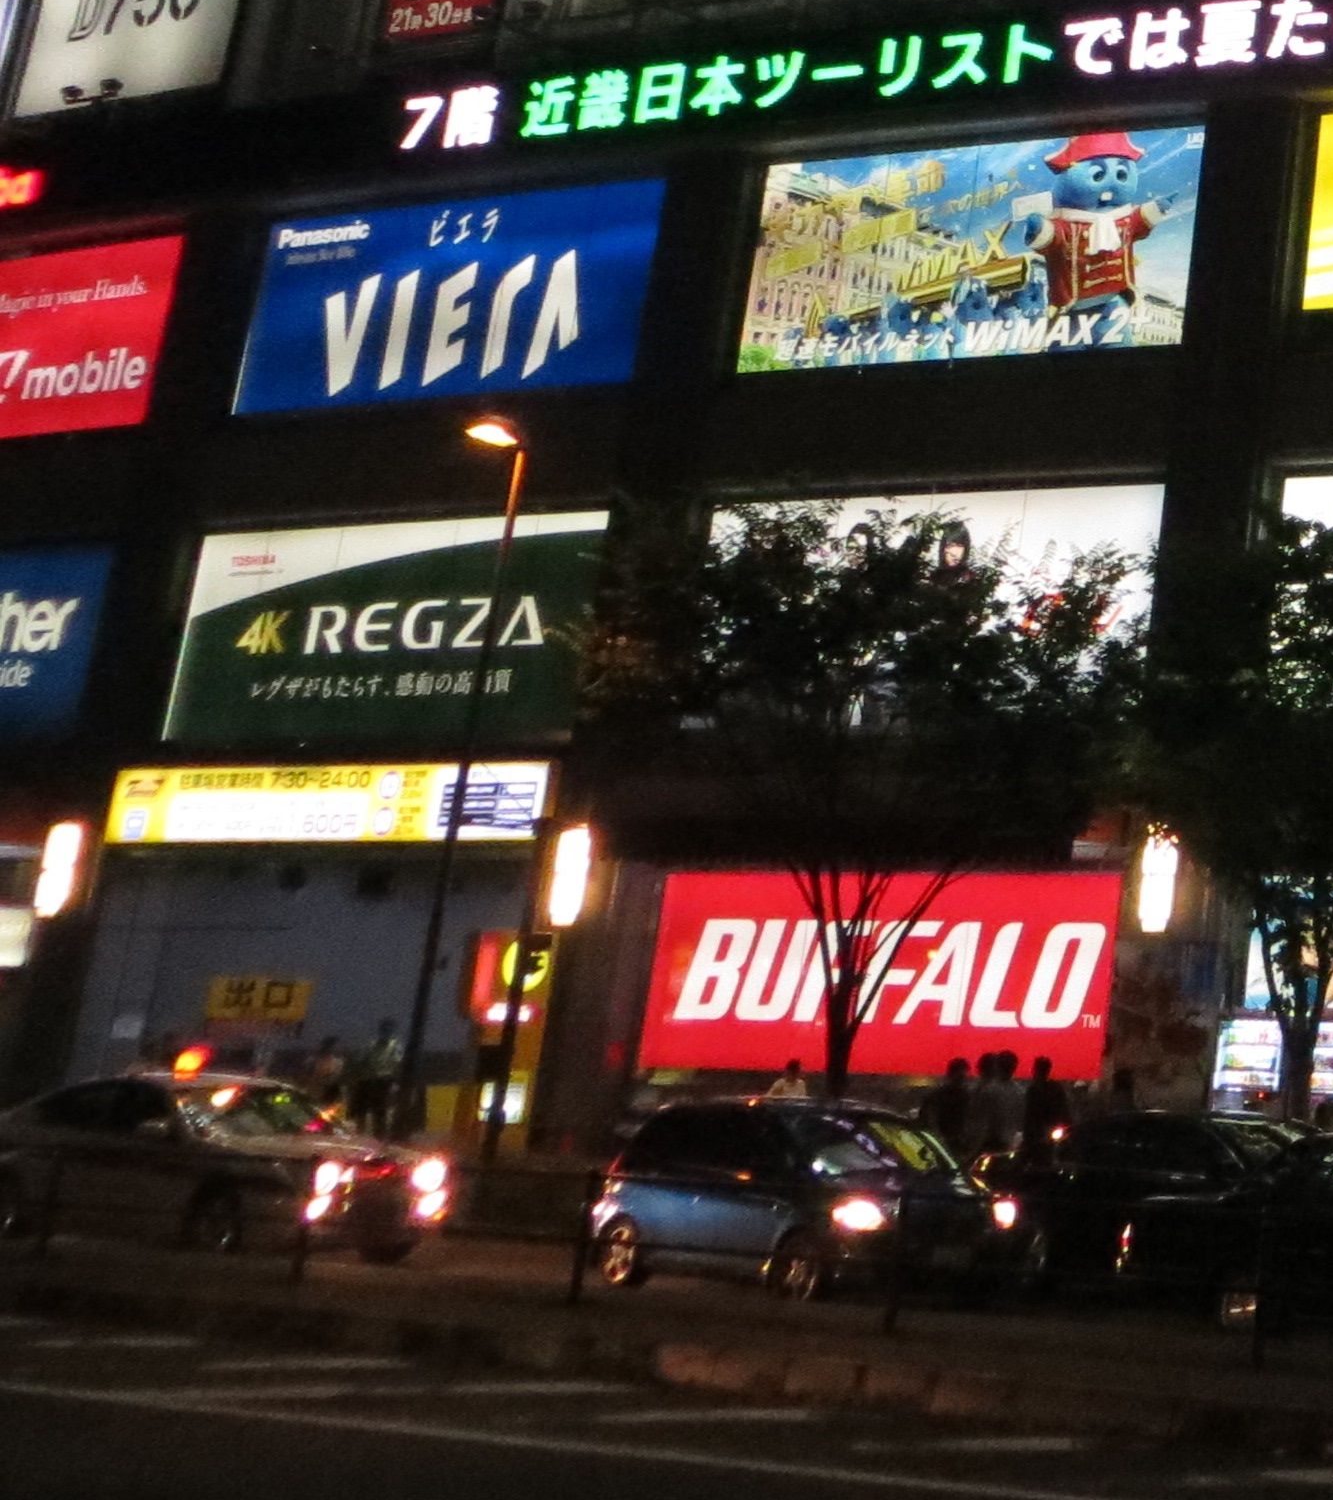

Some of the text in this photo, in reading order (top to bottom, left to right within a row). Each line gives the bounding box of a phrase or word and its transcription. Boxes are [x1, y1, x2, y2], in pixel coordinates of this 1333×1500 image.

[388, 0, 485, 34] 21時30分ま
[519, 22, 1054, 140] 近畿日本ツーリスト
[278, 220, 371, 251] Panasonic
[429, 209, 501, 248] ビエラ
[325, 248, 580, 398] VIERA
[964, 313, 1095, 355] WiMAX
[235, 595, 546, 655] 4K REGZA
